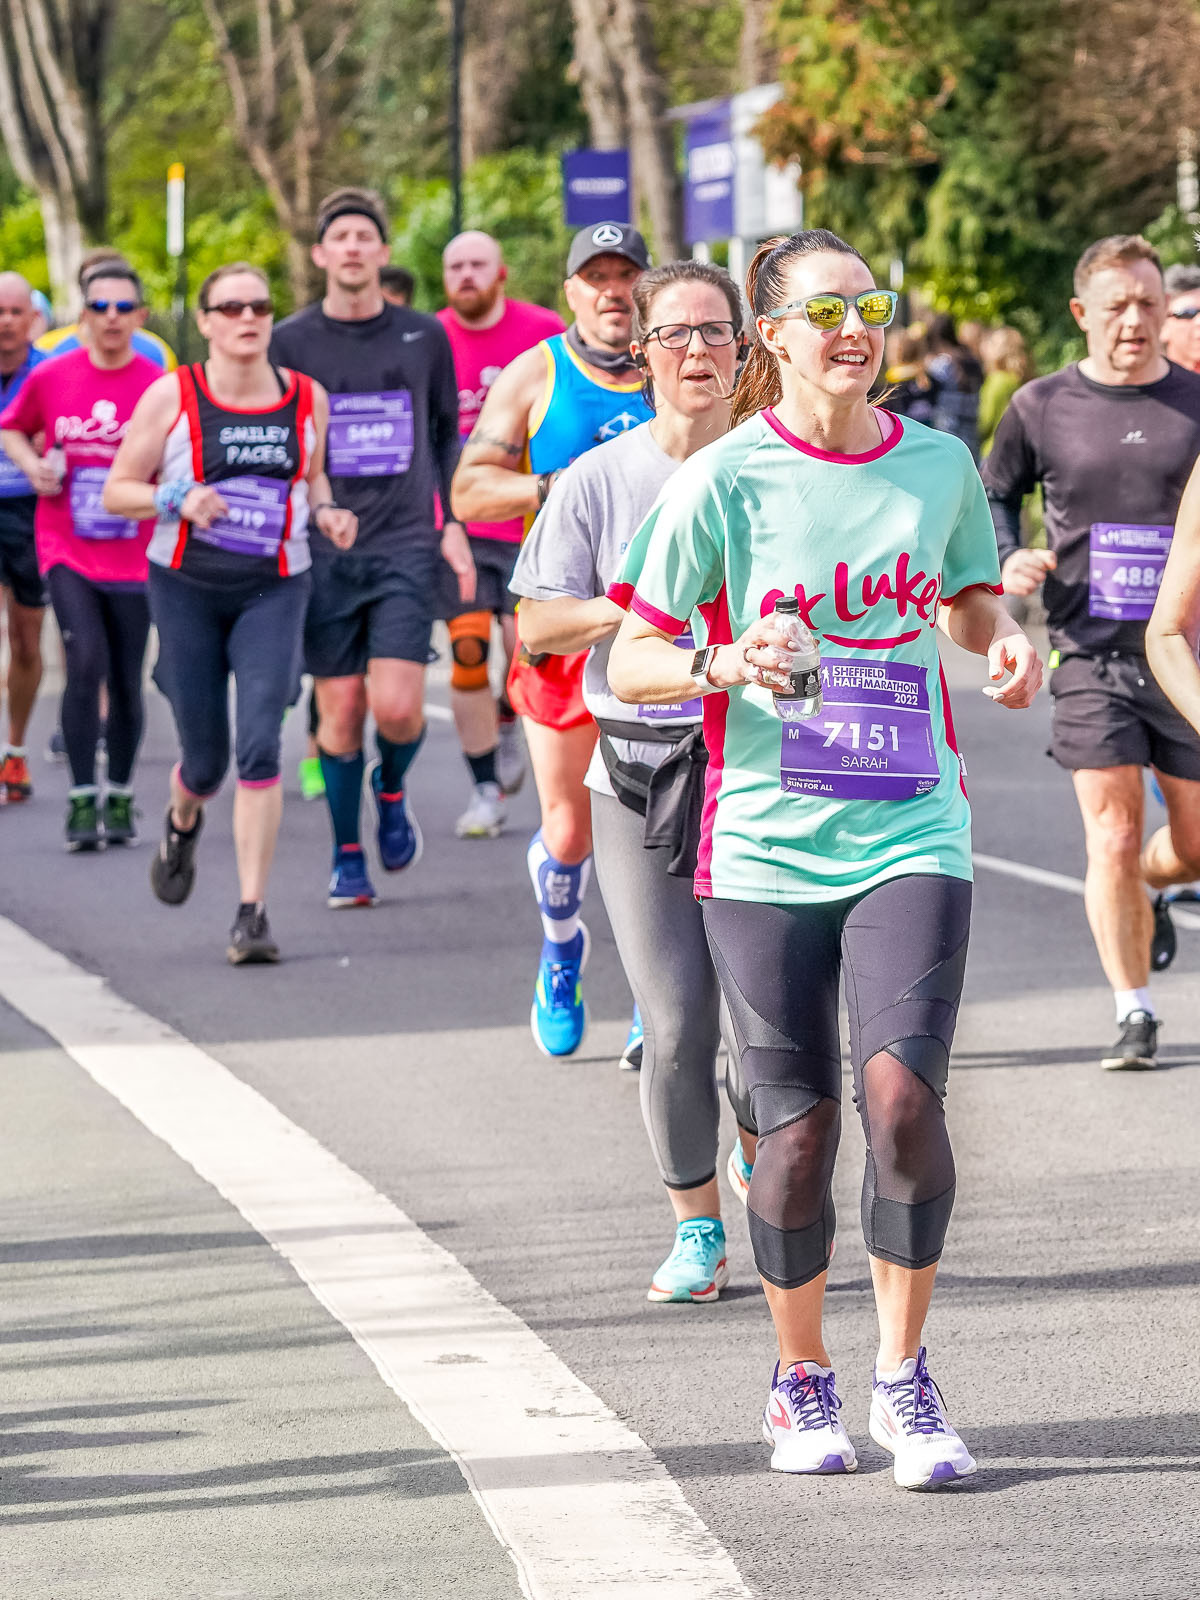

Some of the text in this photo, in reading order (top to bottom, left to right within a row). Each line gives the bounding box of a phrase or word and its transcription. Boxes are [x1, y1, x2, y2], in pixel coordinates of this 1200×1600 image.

[219, 425, 290, 445] SMILEY
[834, 666, 884, 679] SHEFFIELD
[833, 677, 918, 694] HALF MARATHON
[894, 692, 918, 706] 2022
[788, 728, 799, 740] M
[822, 721, 900, 752] 7151
[841, 756, 888, 769] SARAH
[787, 780, 802, 789] RUN
[803, 782, 818, 790] FOR
